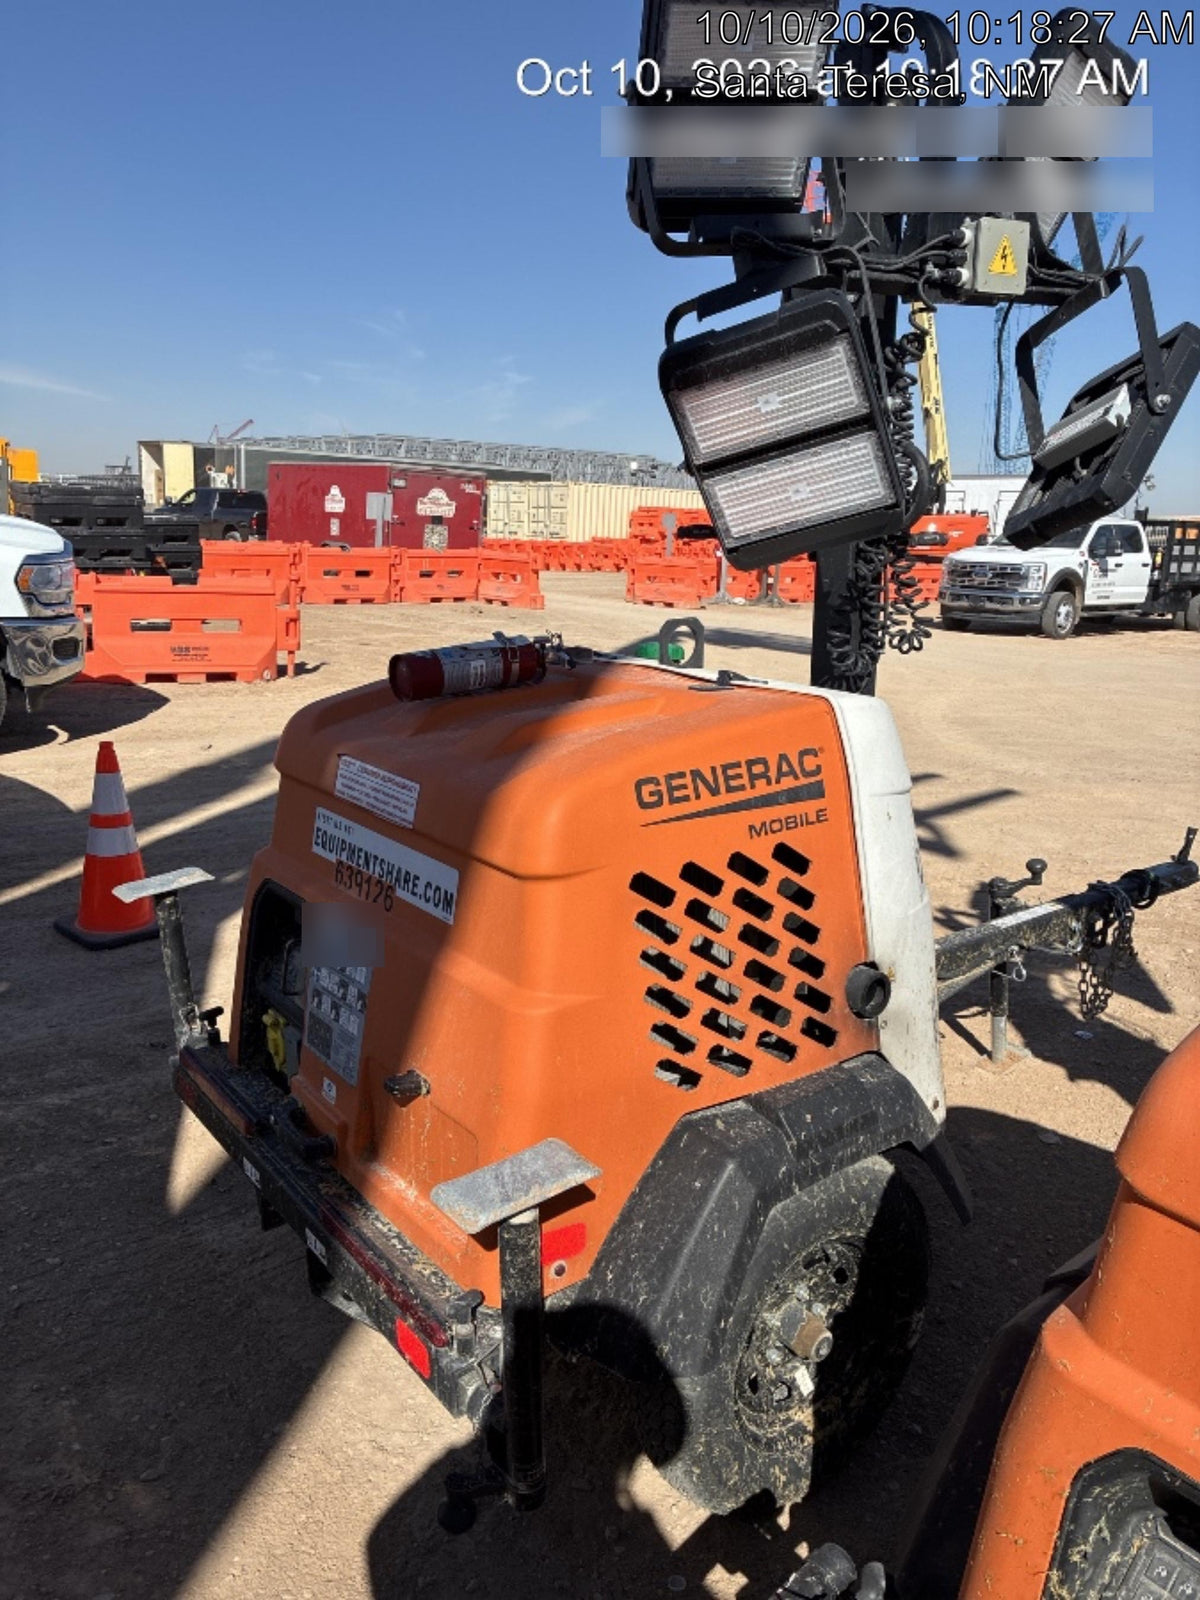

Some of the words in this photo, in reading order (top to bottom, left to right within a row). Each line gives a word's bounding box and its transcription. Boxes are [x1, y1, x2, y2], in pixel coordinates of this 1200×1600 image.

[634, 747, 822, 810] GENERAC
[748, 808, 829, 839] MOBILE
[313, 826, 455, 917] EQUIPMENTSHARE.COM
